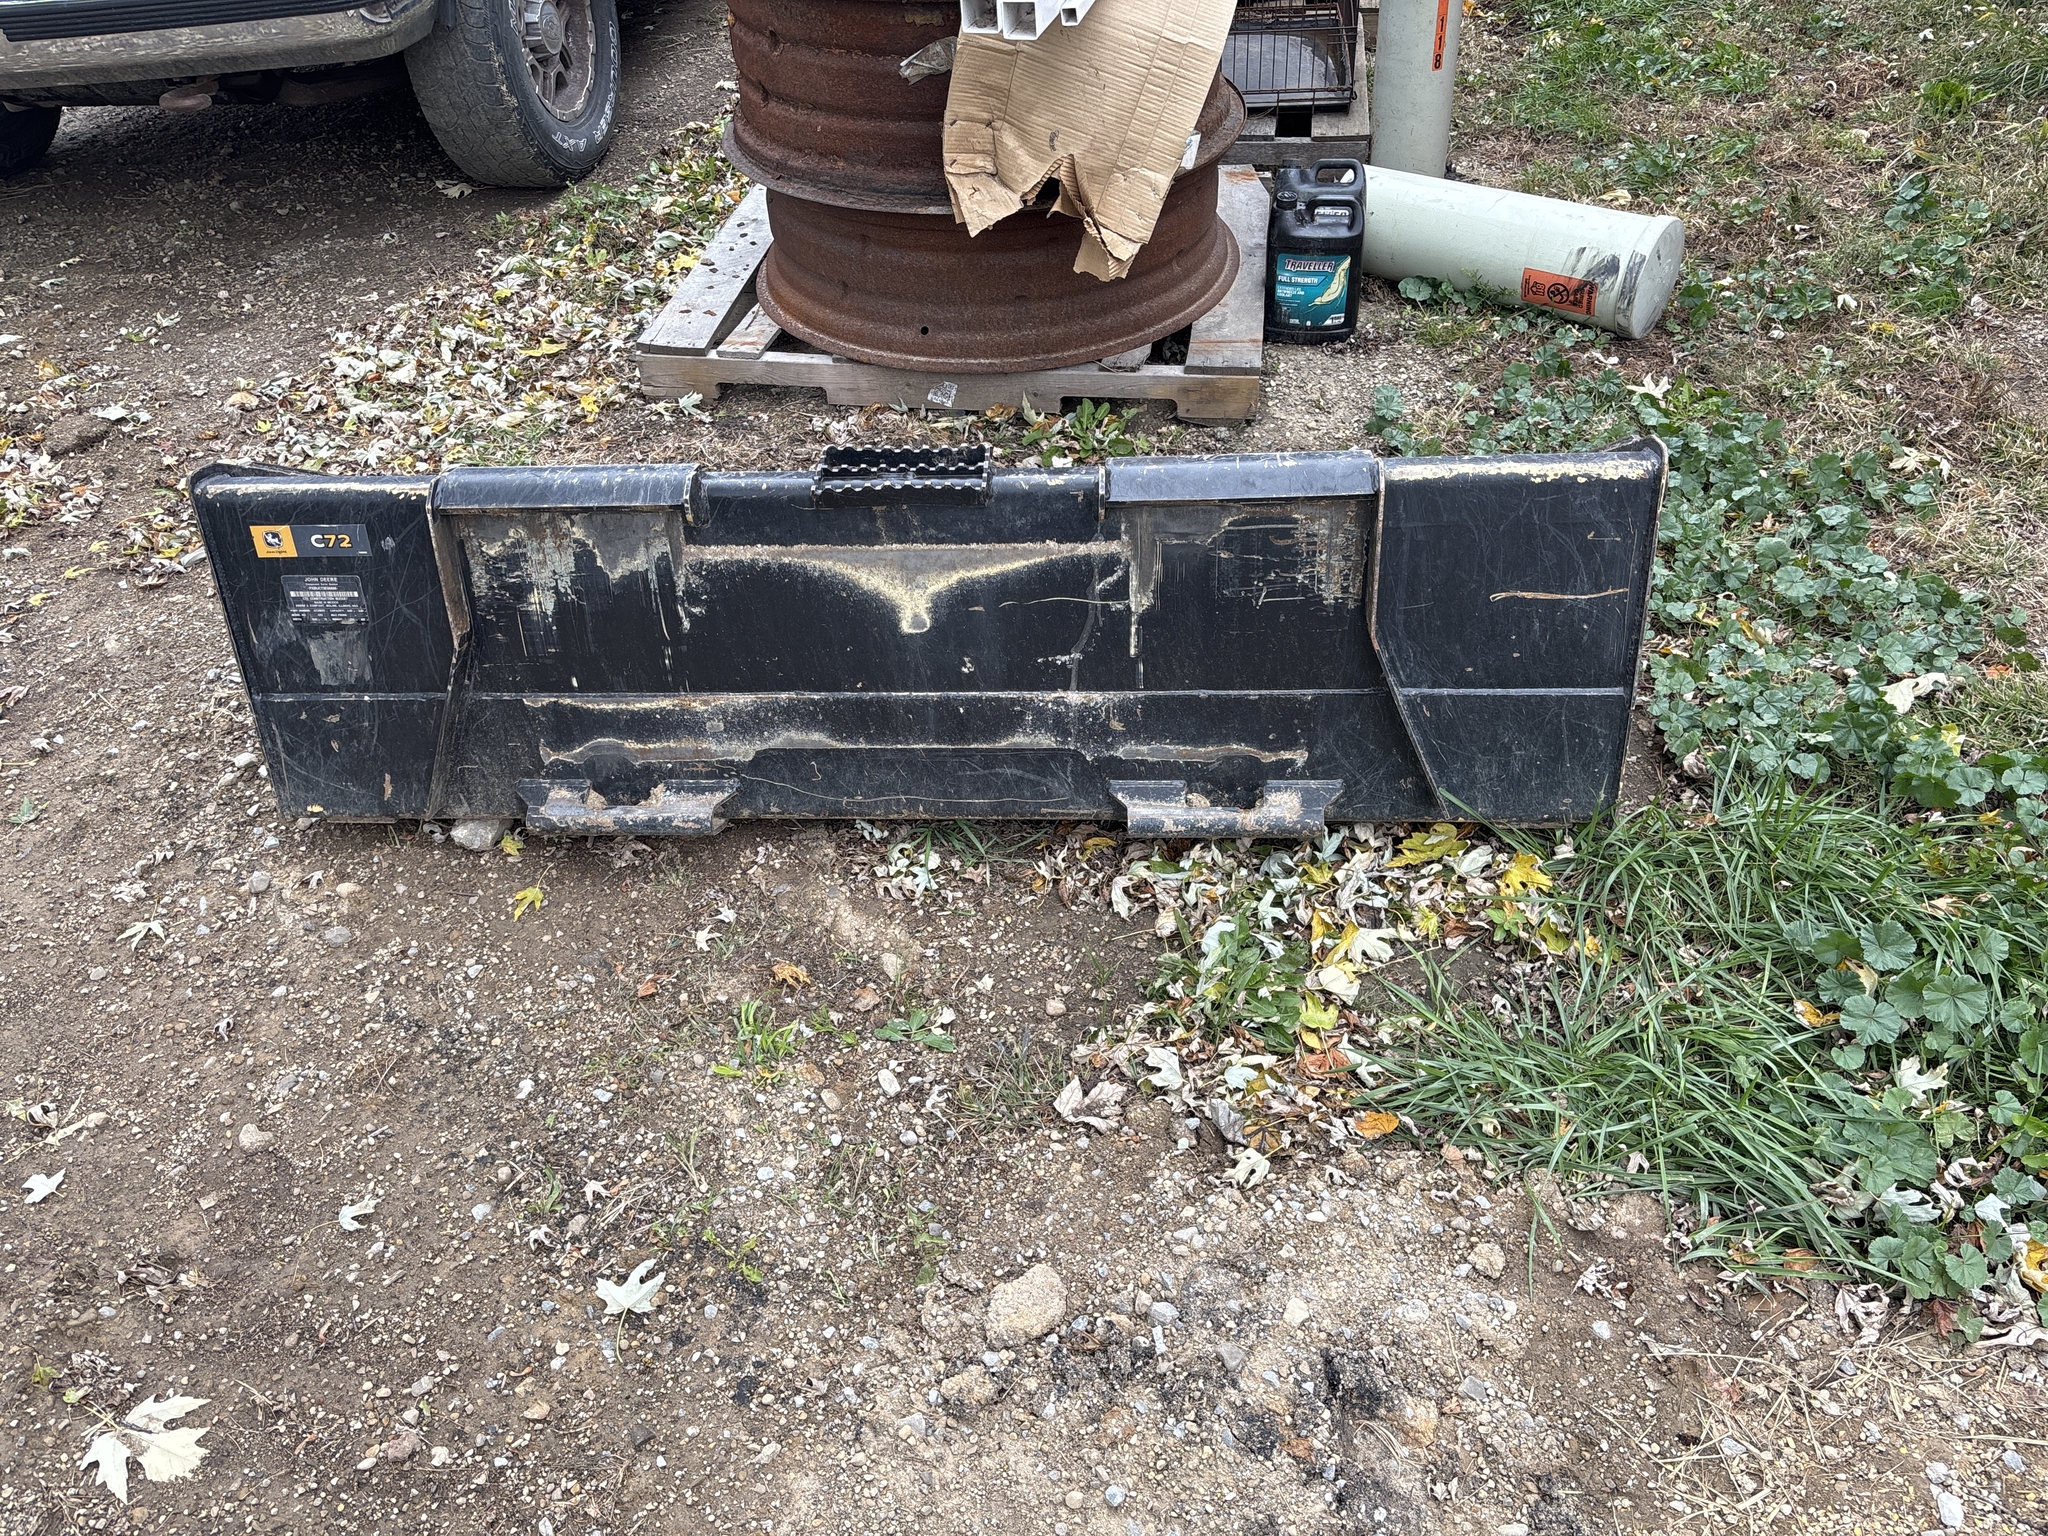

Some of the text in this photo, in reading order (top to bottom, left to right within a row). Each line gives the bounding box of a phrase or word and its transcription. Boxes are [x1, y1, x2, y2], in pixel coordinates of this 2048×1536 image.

[1434, 15, 1445, 69] 118
[552, 131, 587, 152] AXT
[1285, 258, 1334, 272] TRAVELLER
[1291, 276, 1318, 284] STRENGTH
[1585, 282, 1595, 315] WARNING
[310, 534, 353, 548] C72
